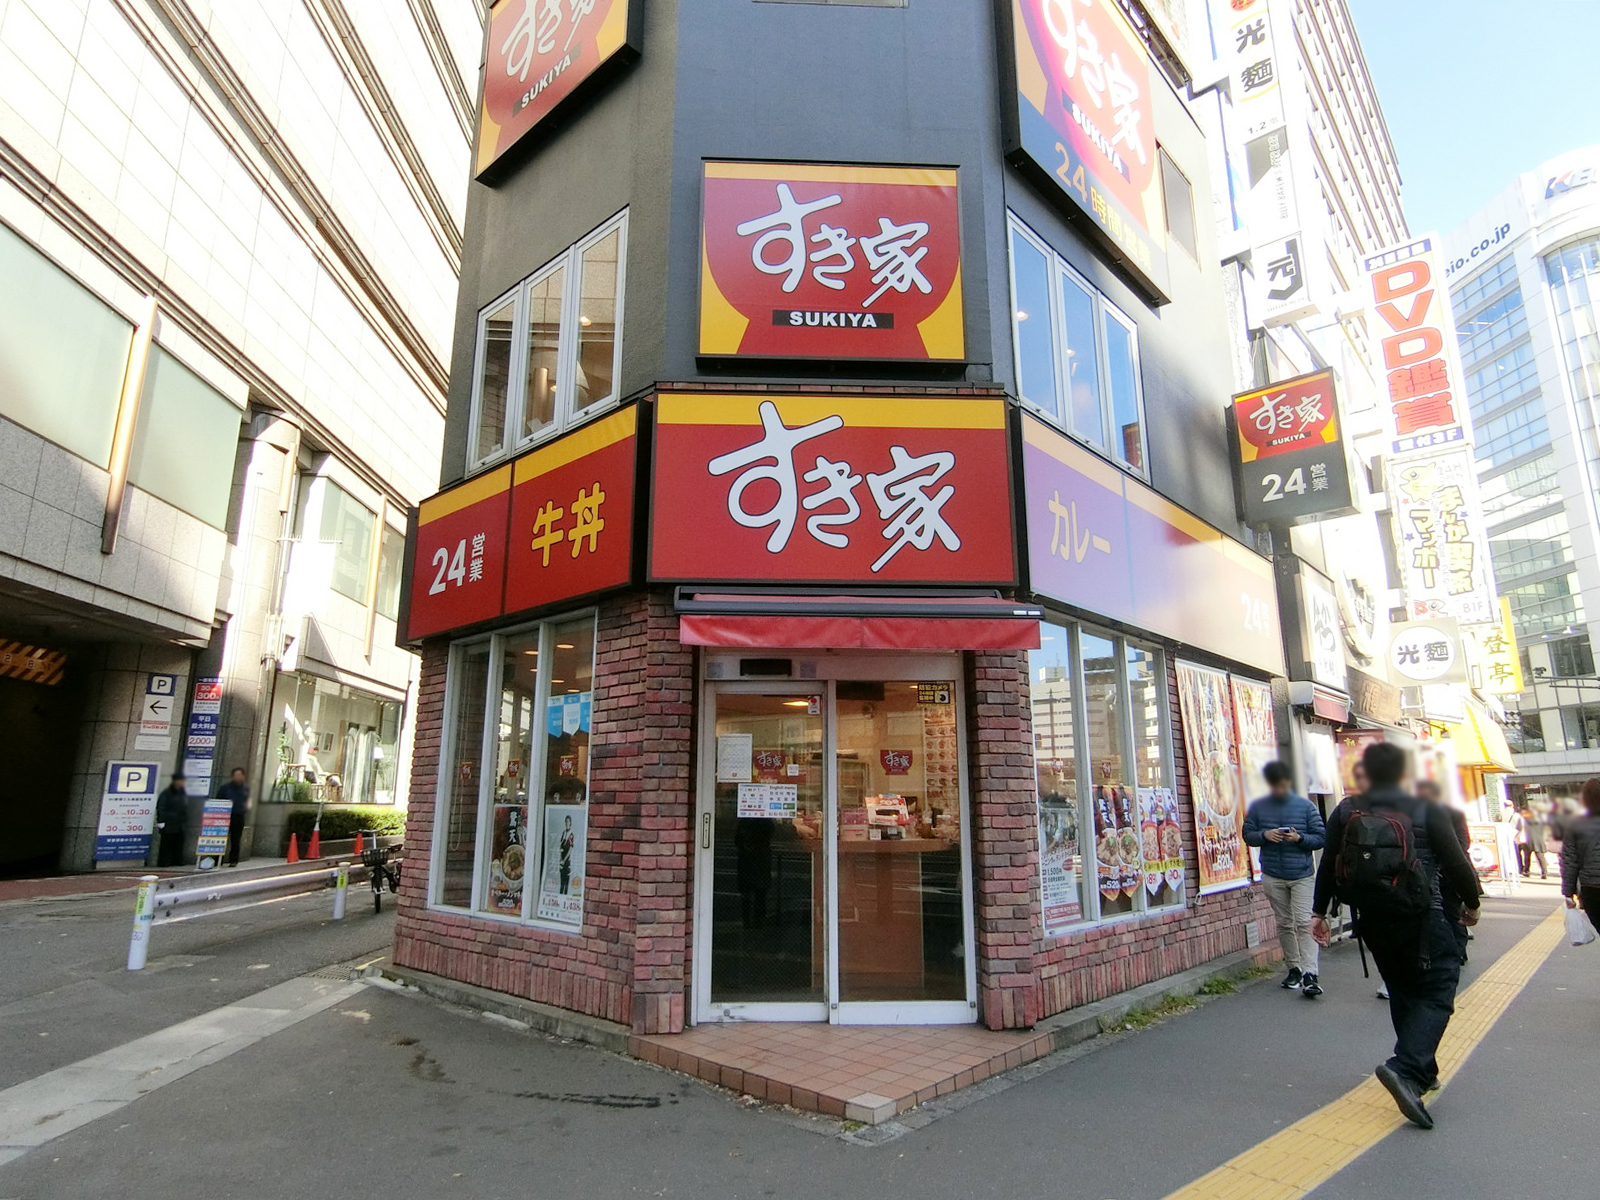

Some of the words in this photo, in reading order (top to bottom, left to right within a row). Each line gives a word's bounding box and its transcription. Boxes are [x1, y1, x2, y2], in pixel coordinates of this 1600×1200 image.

[521, 54, 571, 109] SUKIYA
[1071, 103, 1123, 174] SUKIYA
[736, 182, 933, 308] すき家
[790, 311, 877, 328] SUKIYA
[1250, 392, 1325, 435] すき家
[1272, 433, 1306, 446] SUKIYA
[708, 400, 962, 573] すき家
[1261, 468, 1307, 502] 24
[1310, 462, 1329, 491] 営業
[531, 482, 606, 567] 牛丼
[1048, 490, 1111, 563] カレー
[429, 538, 467, 596] 24
[469, 532, 486, 583] 営業
[157, 679, 167, 690] P
[126, 771, 142, 788] P
[757, 750, 782, 769] すき家
[885, 750, 910, 769] すき家
